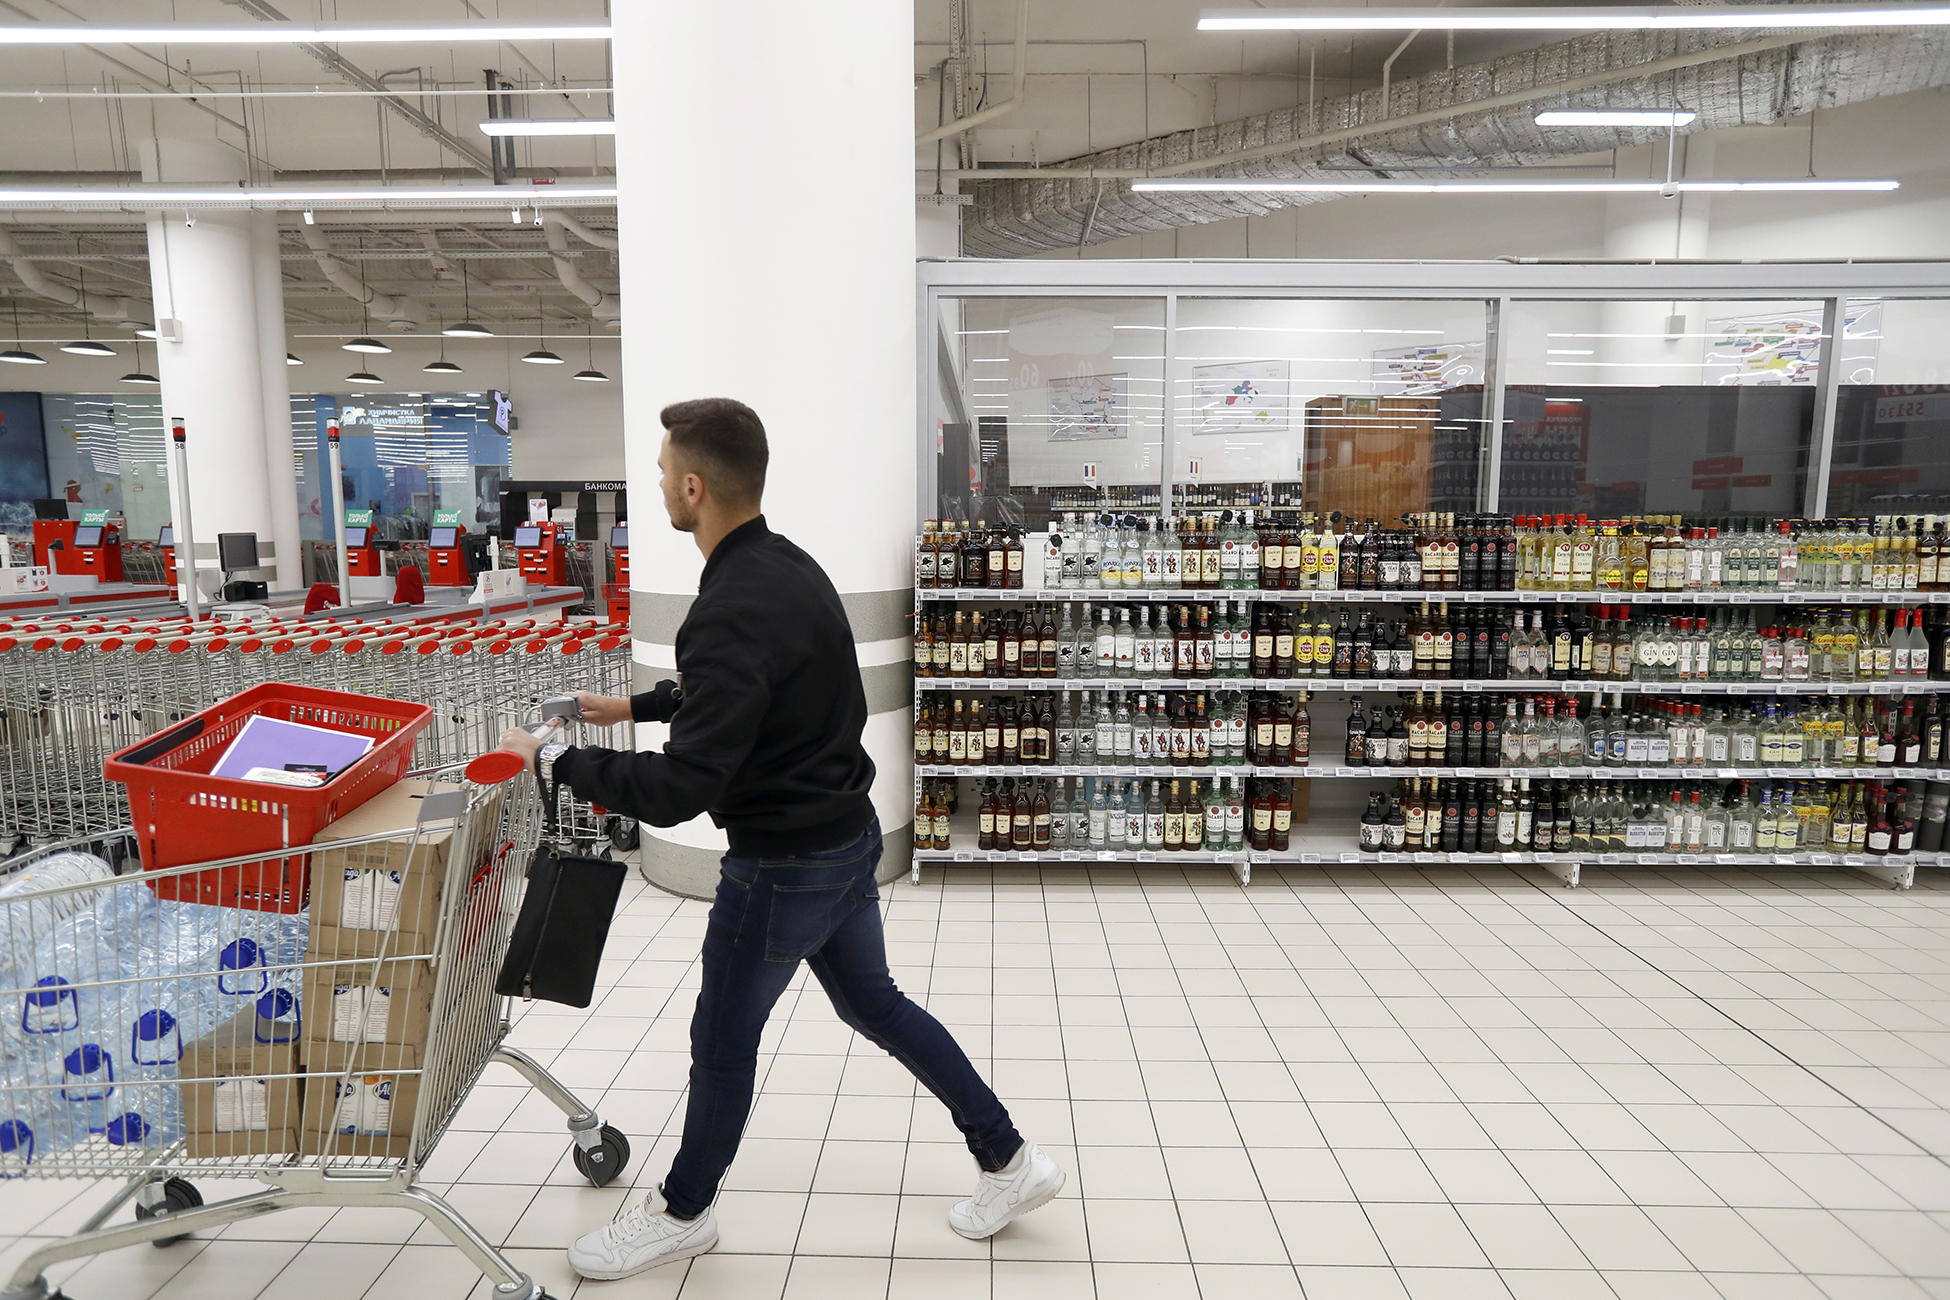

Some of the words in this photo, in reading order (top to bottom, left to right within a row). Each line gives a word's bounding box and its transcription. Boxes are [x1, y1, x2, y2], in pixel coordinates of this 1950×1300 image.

[358, 417, 424, 425] ЛАВАНДЕРИЯ
[175, 442, 185, 450] 58
[329, 442, 339, 450] 59
